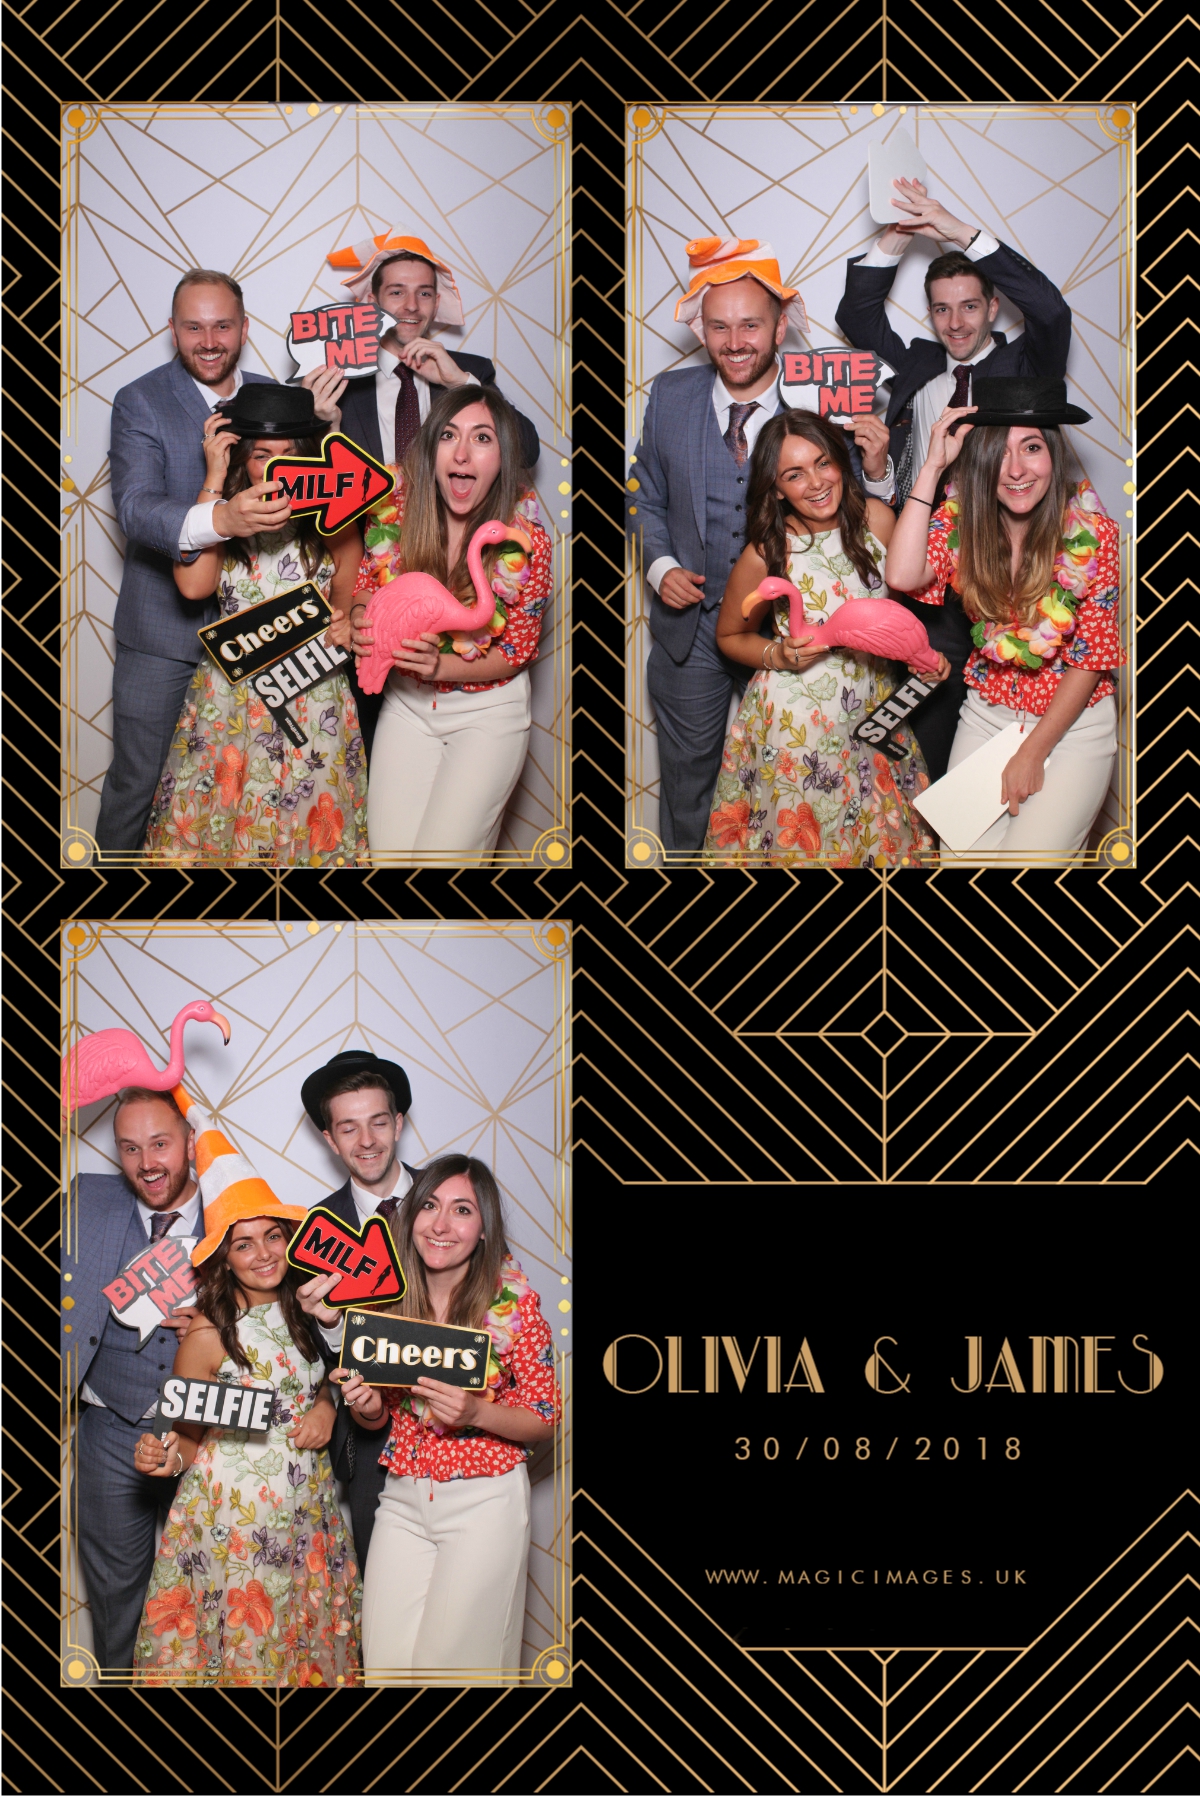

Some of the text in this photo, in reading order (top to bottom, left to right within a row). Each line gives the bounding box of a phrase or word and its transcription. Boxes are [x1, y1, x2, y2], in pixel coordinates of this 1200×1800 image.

[291, 304, 380, 341] BITE
[325, 335, 380, 369] ME
[784, 352, 877, 382] BITE
[819, 385, 875, 417] ME
[277, 472, 355, 501] MILF
[219, 599, 320, 662] Cheers
[858, 672, 939, 743] SELFI
[102, 1238, 183, 1311] BITE
[303, 1226, 378, 1279] MILF
[147, 1262, 198, 1319] ME
[351, 1335, 478, 1371] Cheers
[160, 1379, 273, 1431] SELFIE
